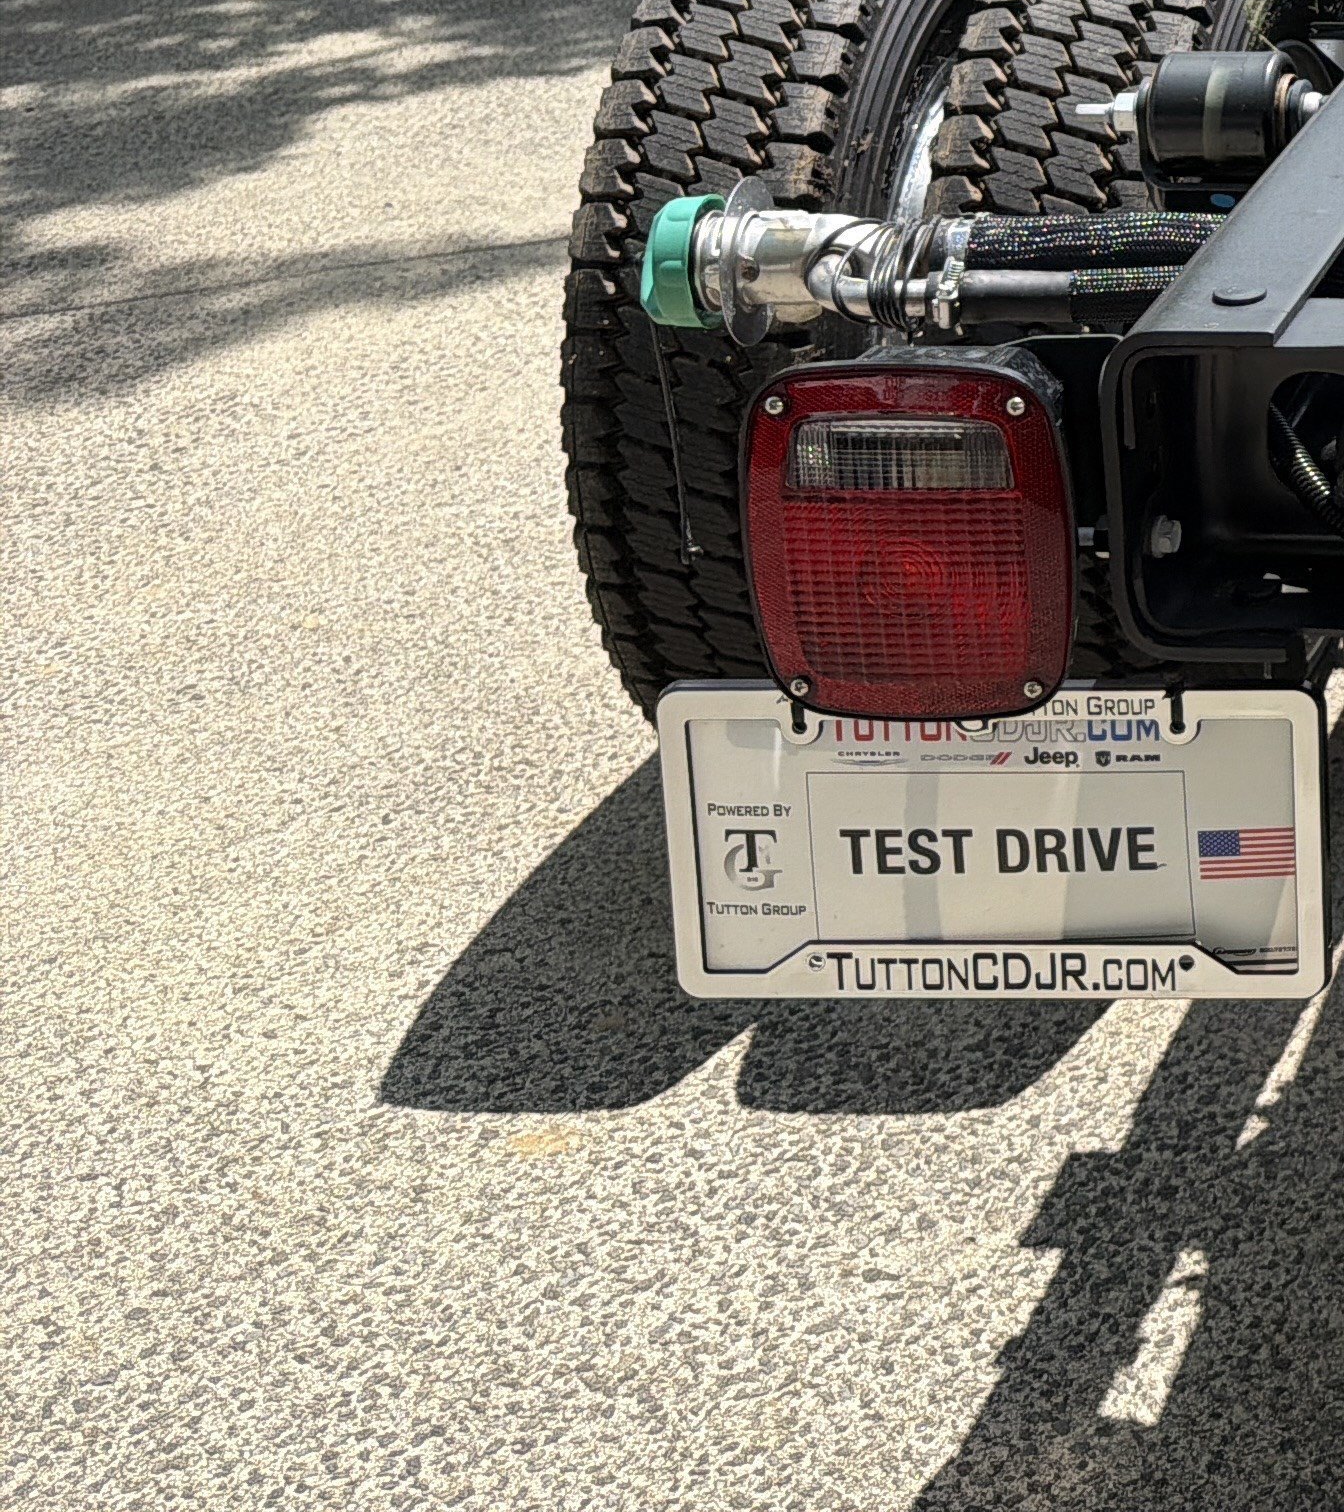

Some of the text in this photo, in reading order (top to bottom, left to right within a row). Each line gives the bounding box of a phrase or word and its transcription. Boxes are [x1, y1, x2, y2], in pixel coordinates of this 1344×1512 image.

[1086, 695, 1156, 717] GROUP
[835, 719, 1160, 743] TUTTONDJR.COM
[1024, 747, 1078, 767] Jeep
[1115, 753, 1161, 763] RAM
[838, 826, 1160, 875] TEST DRIVE
[706, 901, 807, 916] TUTTON GROUP
